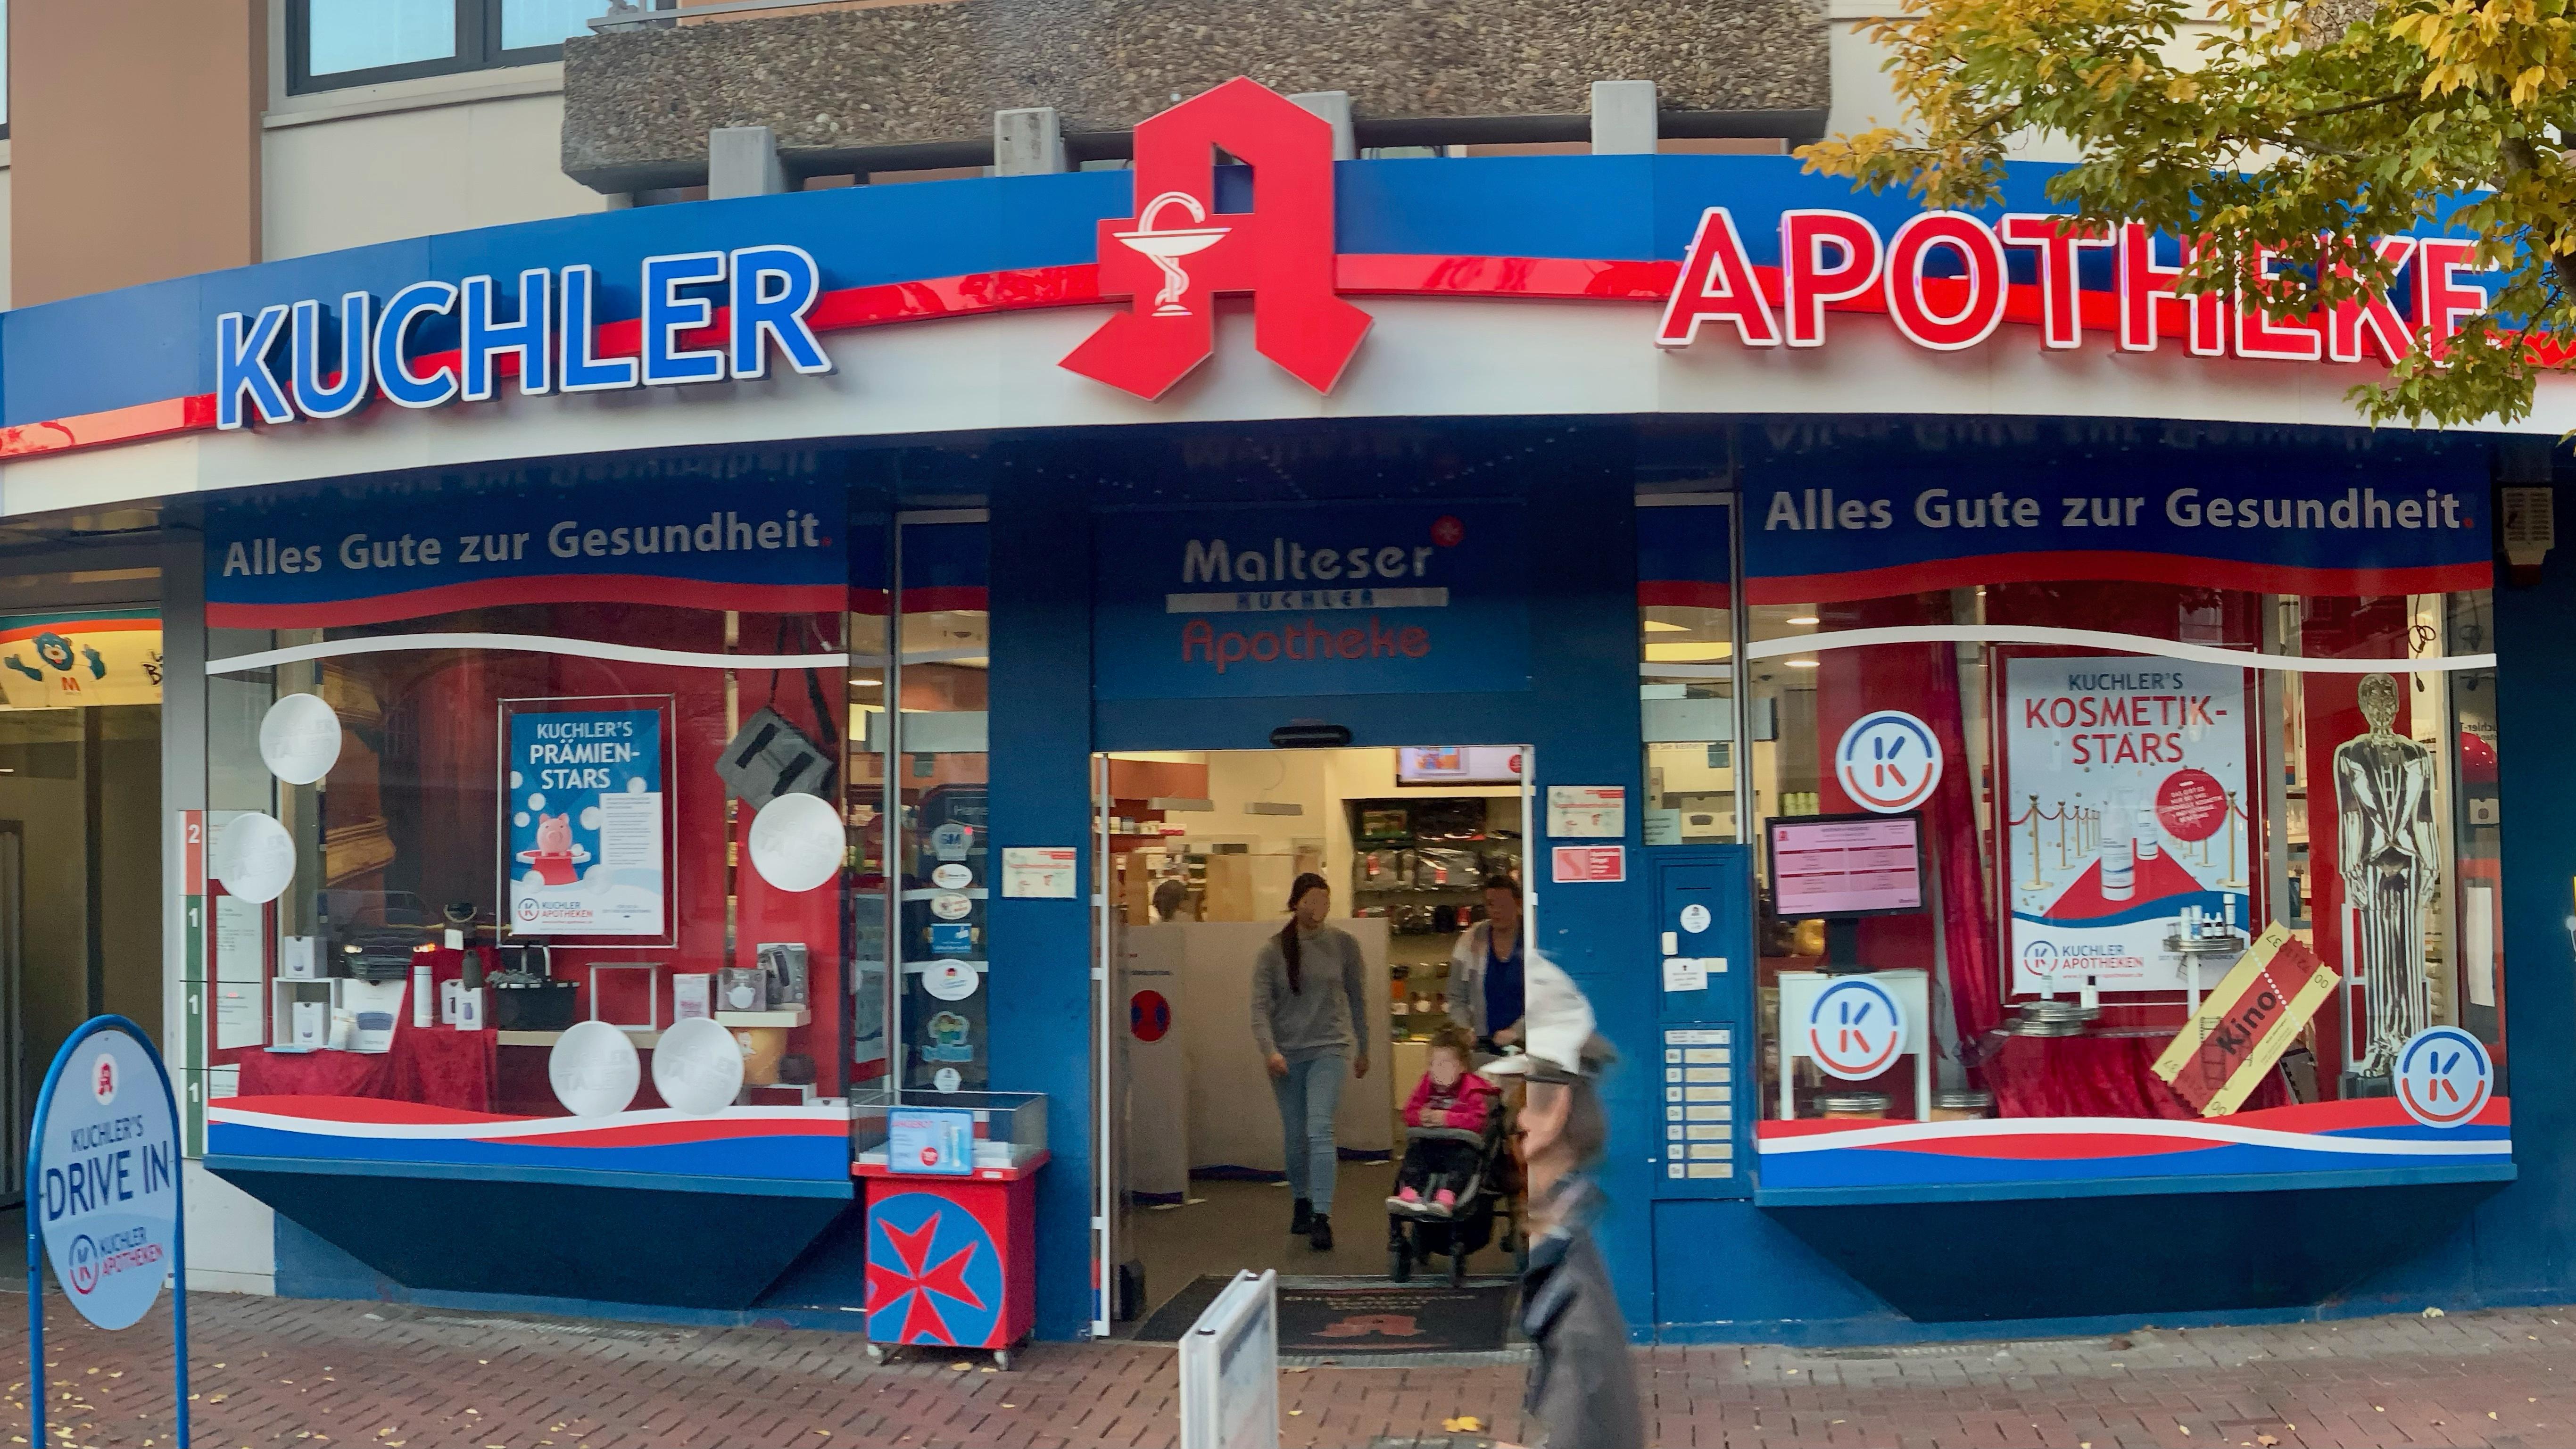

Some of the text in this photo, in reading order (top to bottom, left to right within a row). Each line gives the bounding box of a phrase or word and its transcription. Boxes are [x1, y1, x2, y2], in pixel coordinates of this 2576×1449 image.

[216, 244, 832, 430] KUCHLER
[1765, 488, 2475, 530] Alles Gute zur Gesundheit.
[223, 510, 833, 577] Alles Gute zur Gesundheit.
[1183, 538, 1433, 583] Malteser
[1236, 592, 1375, 611] KUCHLER
[1182, 616, 1431, 675] Apotheke
[62, 677, 81, 692] M
[2068, 672, 2184, 691] KUCHLER'S
[2024, 696, 2228, 729] KOSMETIK-
[537, 721, 633, 739] KUCHLER'S
[530, 737, 640, 764] PRÄMIEN-
[2071, 733, 2184, 765] STARS
[540, 768, 612, 790] STARS
[188, 824, 200, 844] 2
[189, 908, 198, 927] 1
[2062, 944, 2124, 957] KUCHLER
[2062, 957, 2145, 969] APOTHEKEN
[189, 995, 198, 1015] 1
[2216, 992, 2277, 1055] Kino
[189, 1083, 199, 1103] 1
[71, 1114, 144, 1153] KUCHLER'S
[47, 1140, 170, 1222] DRIVE IN
